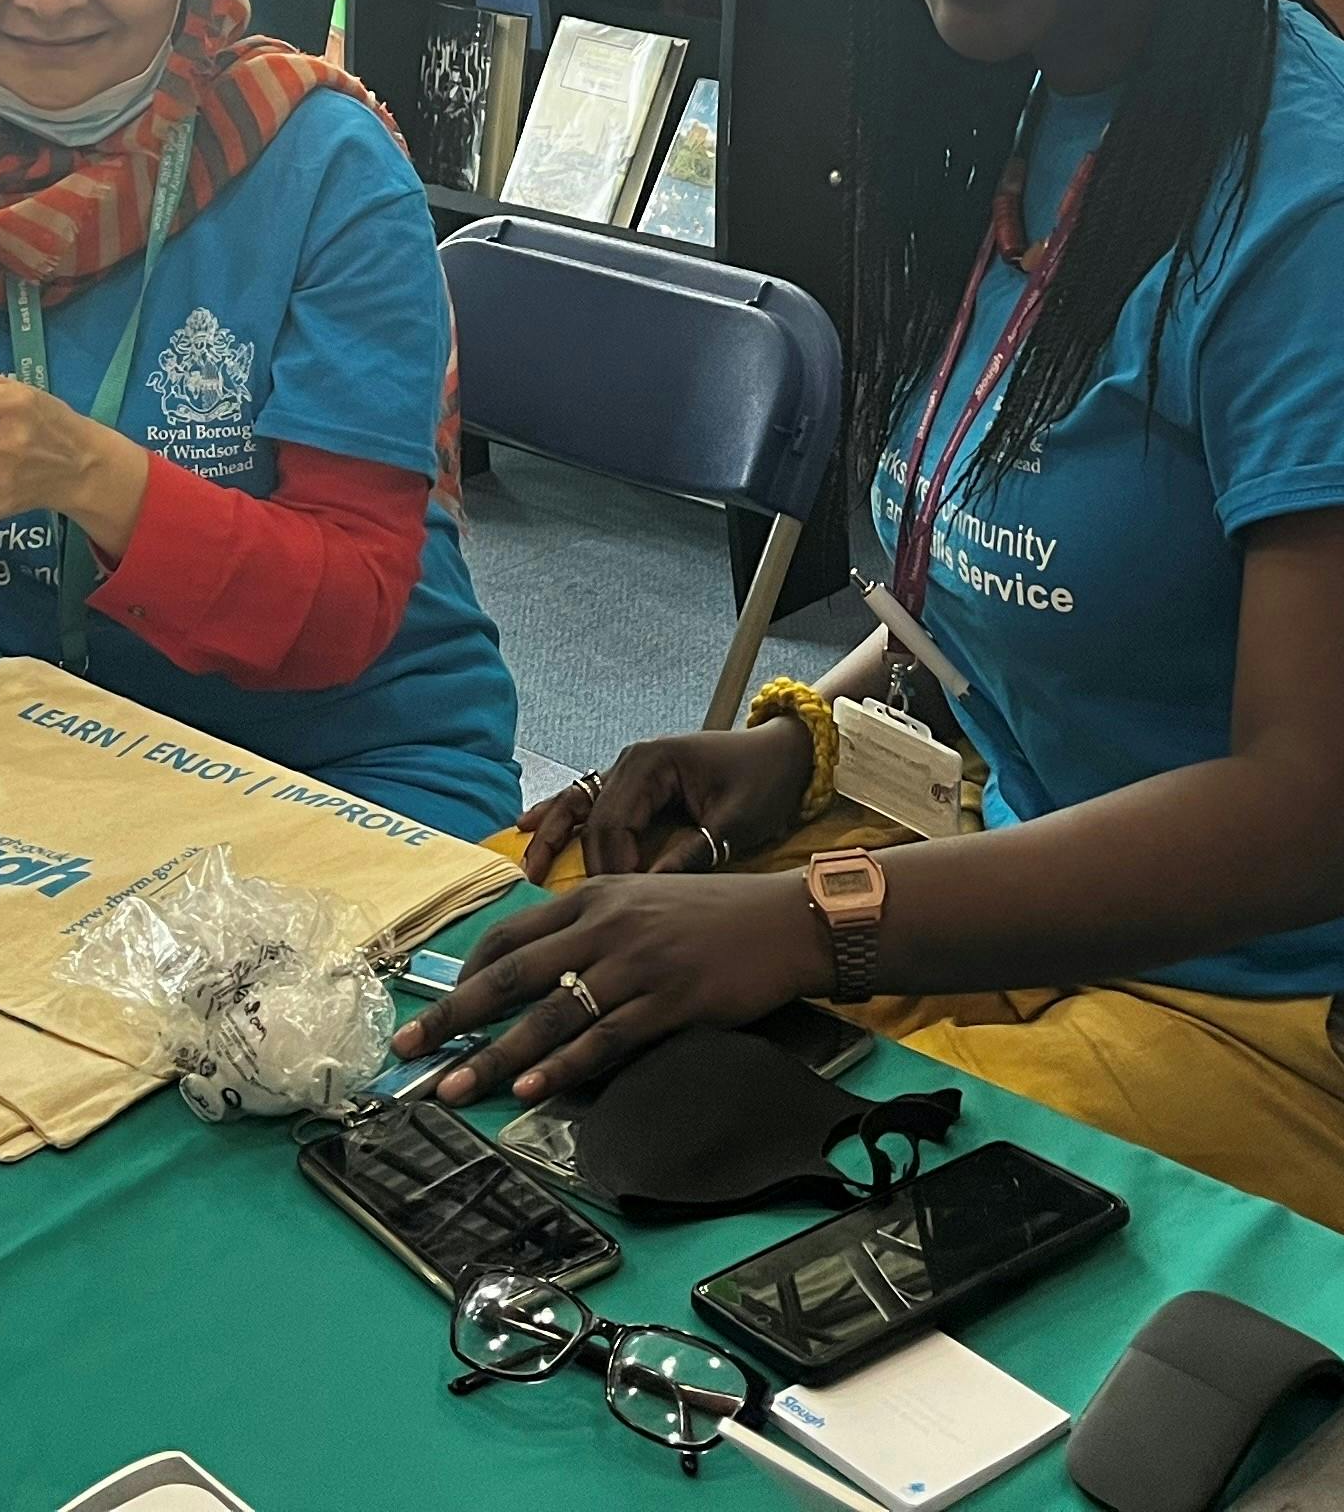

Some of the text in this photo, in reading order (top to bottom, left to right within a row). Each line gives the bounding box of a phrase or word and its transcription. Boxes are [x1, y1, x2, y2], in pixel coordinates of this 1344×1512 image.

[147, 420, 254, 445] Royal Boroug
[173, 443, 240, 460] Windsor
[243, 440, 257, 453] &
[958, 548, 1074, 612] Service
[17, 702, 127, 748] LEARN
[143, 742, 255, 785] ENJOY
[272, 784, 439, 847] IMPROVE
[779, 1395, 826, 1429] Slough
